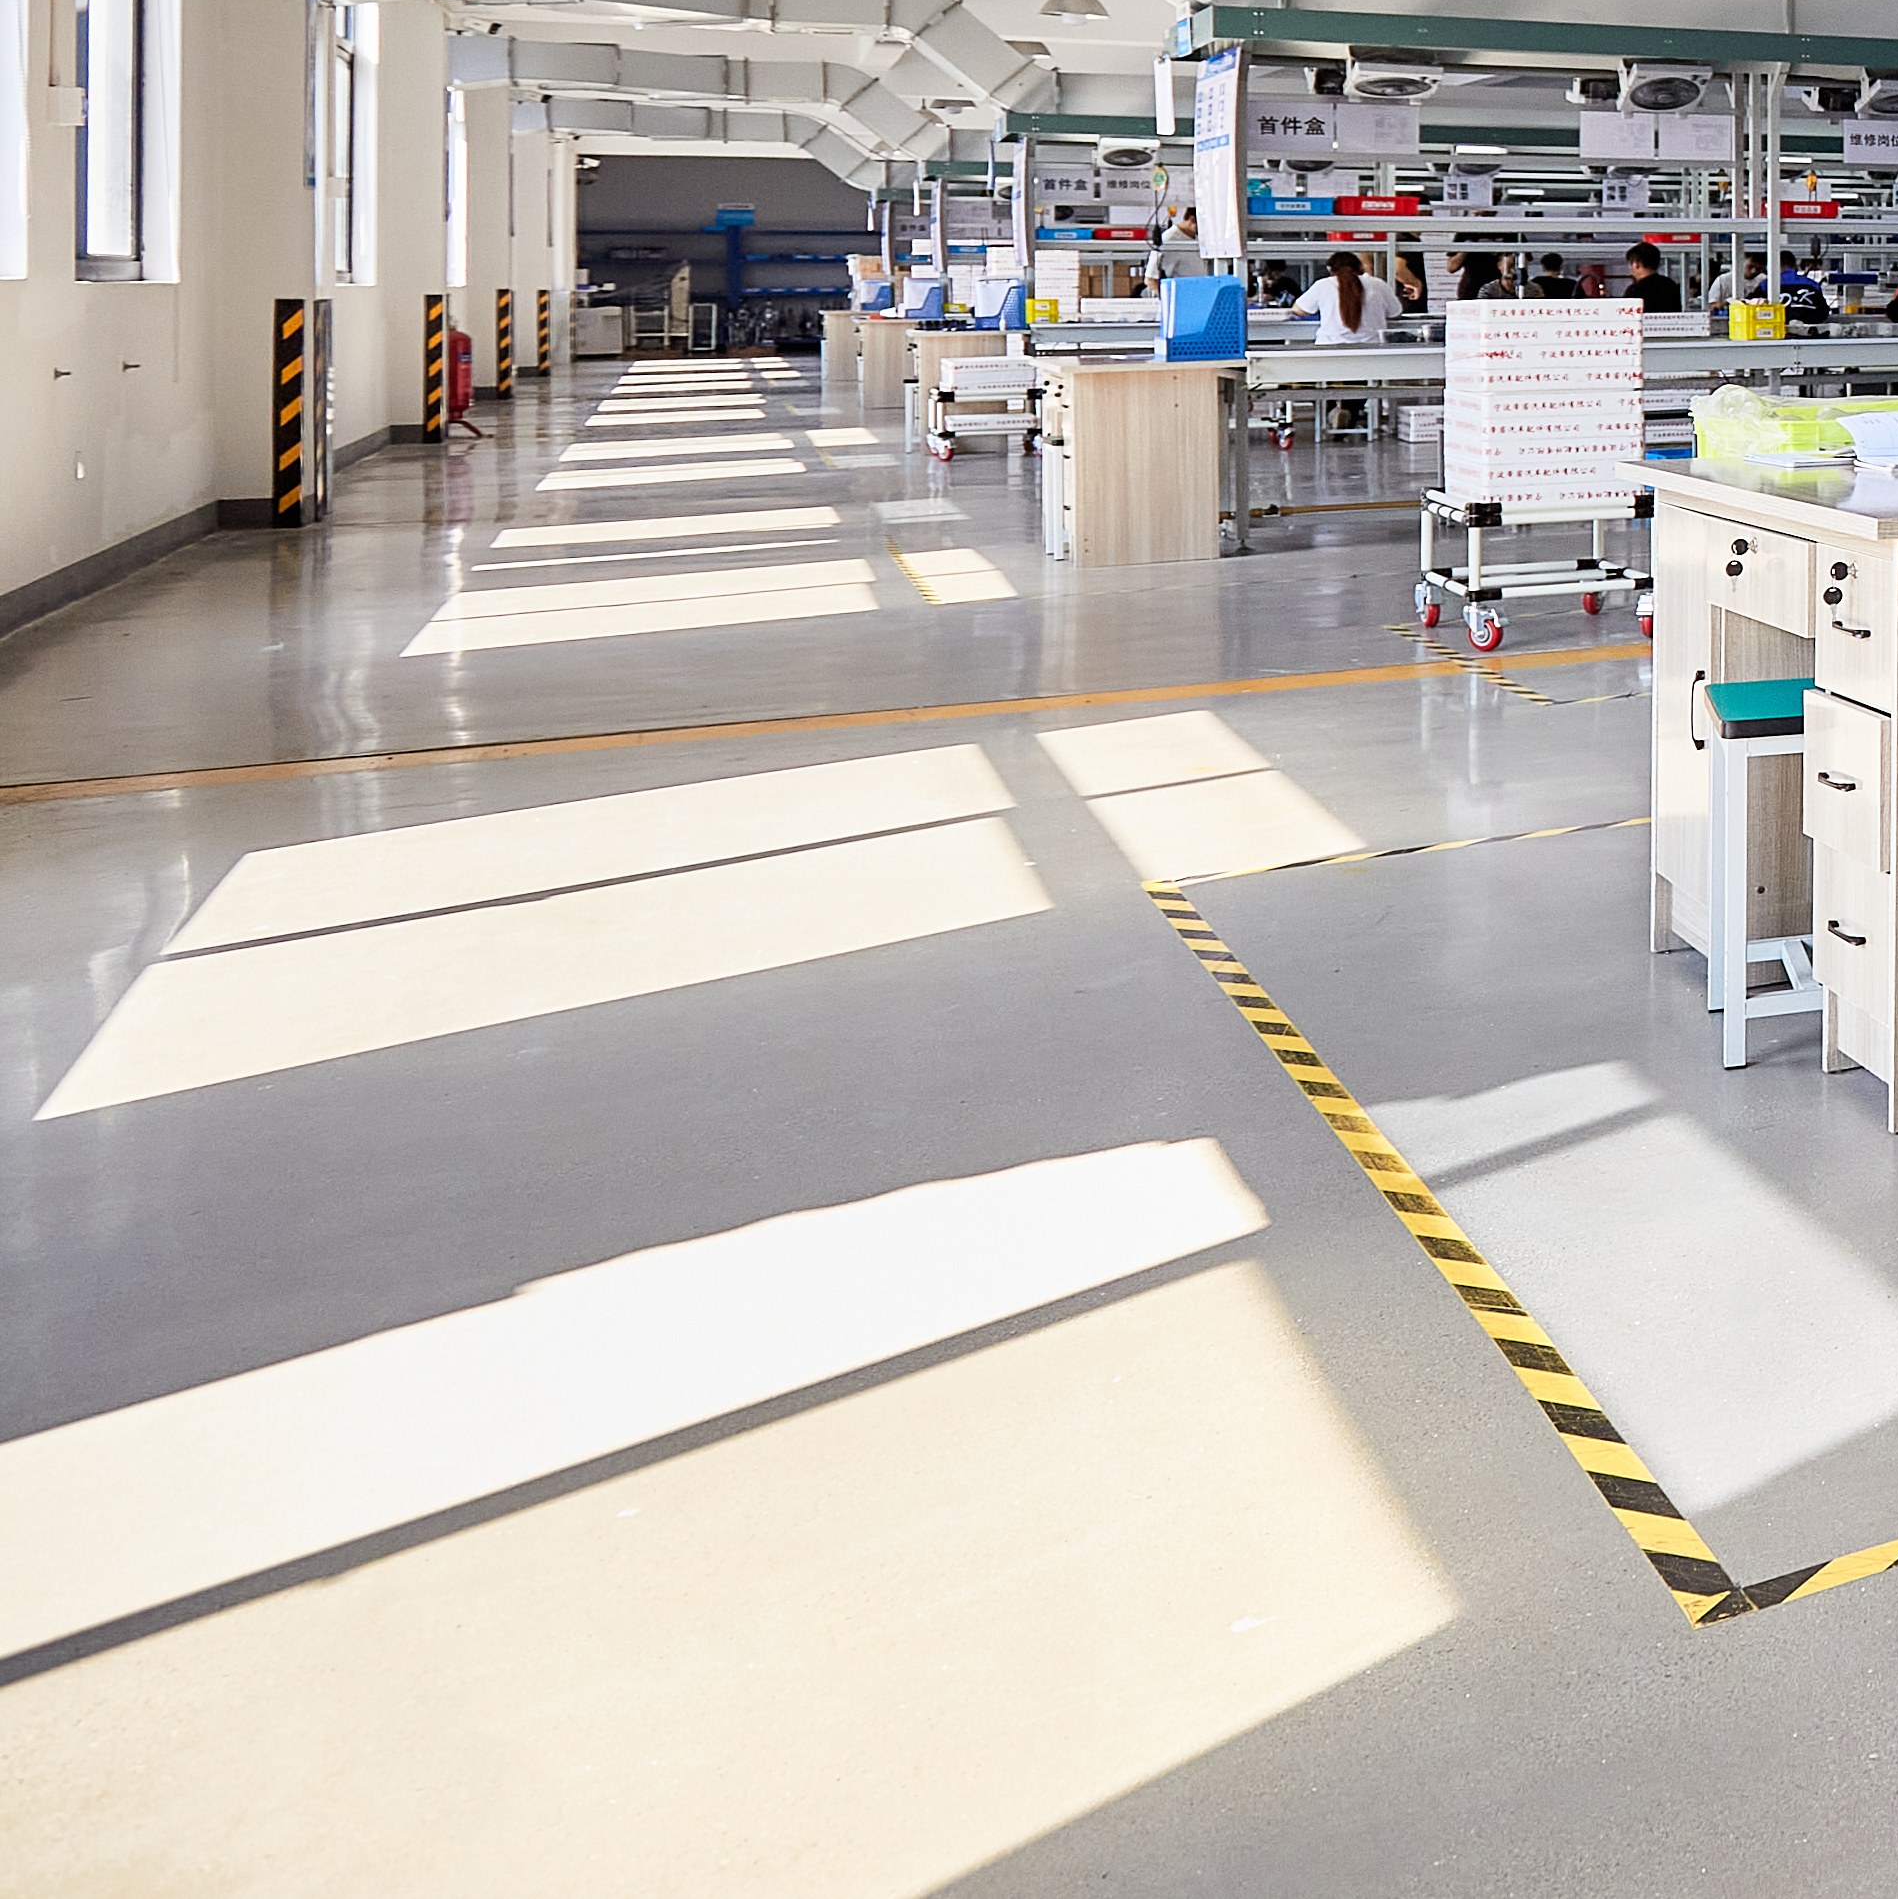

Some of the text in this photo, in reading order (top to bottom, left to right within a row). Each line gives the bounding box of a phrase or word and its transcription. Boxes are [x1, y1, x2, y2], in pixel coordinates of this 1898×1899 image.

[1257, 116, 1325, 135] 首件盒
[1043, 179, 1088, 190] 首件盒
[1107, 180, 1150, 189] 维修岗位
